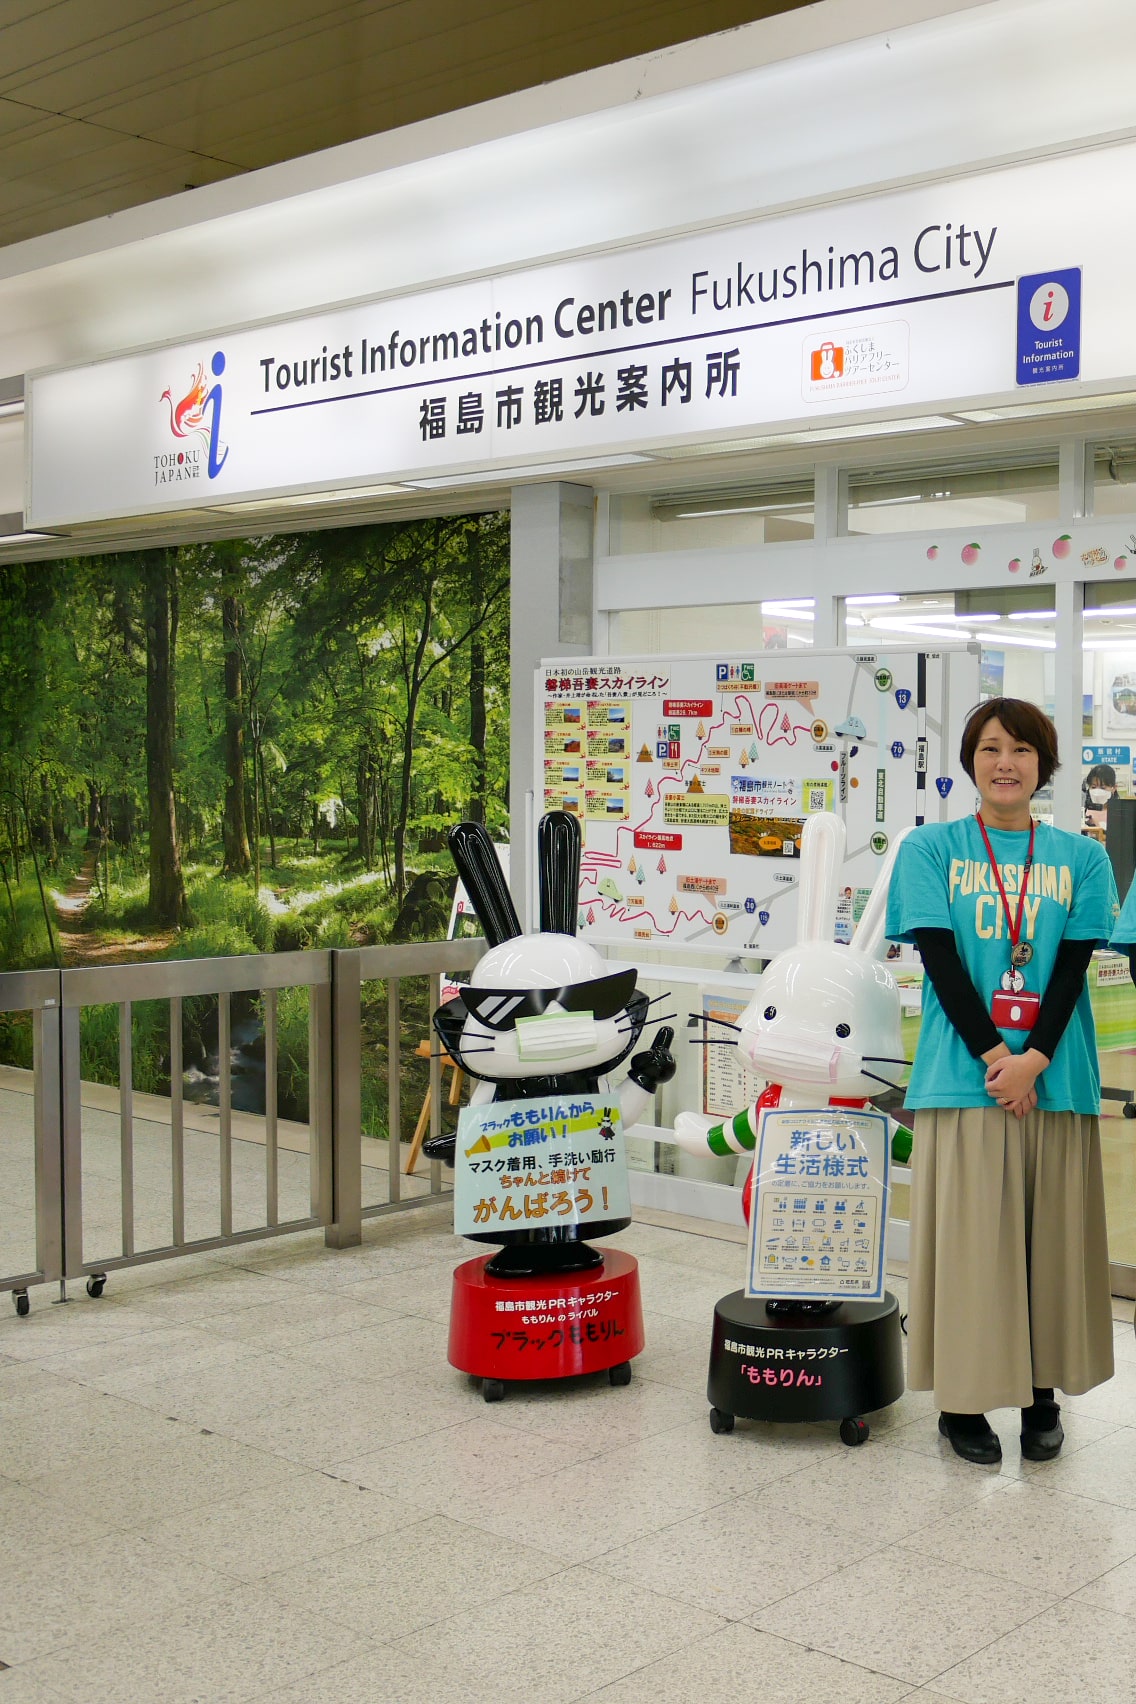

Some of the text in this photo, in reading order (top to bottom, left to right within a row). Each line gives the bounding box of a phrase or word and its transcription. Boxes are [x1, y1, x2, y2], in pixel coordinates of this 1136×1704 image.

[260, 222, 997, 392] Tourist Information Center Fukushima City
[845, 342, 876, 355] ふくしま
[1035, 338, 1063, 350] Tourist
[1023, 350, 1074, 364] Information
[1032, 364, 1064, 374] 観光案内所
[420, 347, 740, 441] 福島市観光案内所
[154, 450, 200, 468] TOHOKU
[155, 467, 191, 486] JAPAN
[545, 666, 621, 677] 日本初の山岳観光道路
[545, 676, 669, 692] 磐梯吾妻スカイライン
[899, 694, 907, 703] 13
[917, 744, 925, 768] 福島駅
[941, 783, 946, 791] 4
[480, 1101, 595, 1132] ブラックももりんから
[508, 1124, 568, 1147] お願い！
[790, 1129, 856, 1151] 新しい
[469, 1148, 616, 1174] マスク着用、手洗い励行
[774, 1153, 868, 1178] 生活様式
[499, 1167, 592, 1189] ちゃんと続けて
[473, 1186, 609, 1223] がんばろう！
[741, 1364, 822, 1387] 「ももりん」
